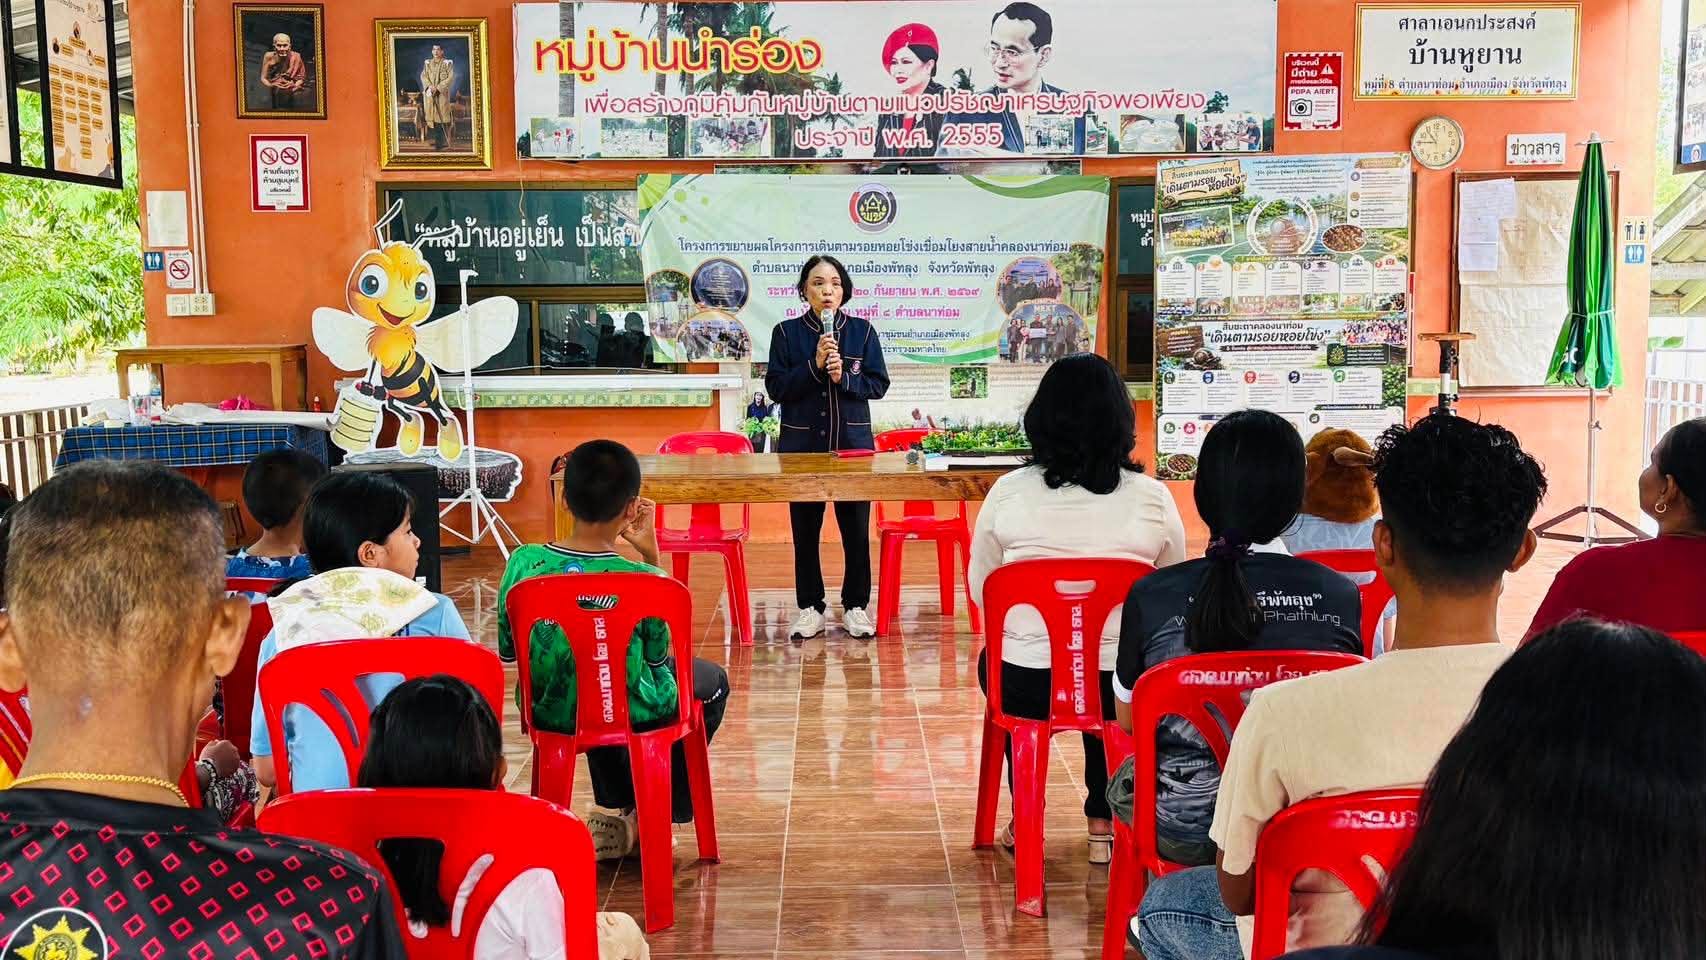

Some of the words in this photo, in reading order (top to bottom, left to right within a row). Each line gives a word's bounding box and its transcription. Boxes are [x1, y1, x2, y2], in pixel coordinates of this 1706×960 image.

[1398, 11, 1537, 31] ศาลาเอนกประสงค์
[534, 28, 823, 83] หมู่บ้านนำร่อง
[1408, 38, 1522, 73] บ้านหูยาน
[584, 89, 1206, 119] เพื่อสร้างภูมิคุ้มกันหมู่บ้านตามแนวปรัชญาเศรษฐกิจพอเพียง
[796, 125, 874, 147] ประจำปี
[884, 130, 933, 147] พ.ศ.
[943, 124, 1003, 147] 2555
[1511, 138, 1561, 156] ข่าวสาร
[928, 261, 995, 277] จังหวัดพัทลุง
[874, 284, 916, 296] กันยายน
[896, 304, 960, 318] ตำบลนาท่อม
[882, 343, 947, 353] ระทรวงมหาดไทย
